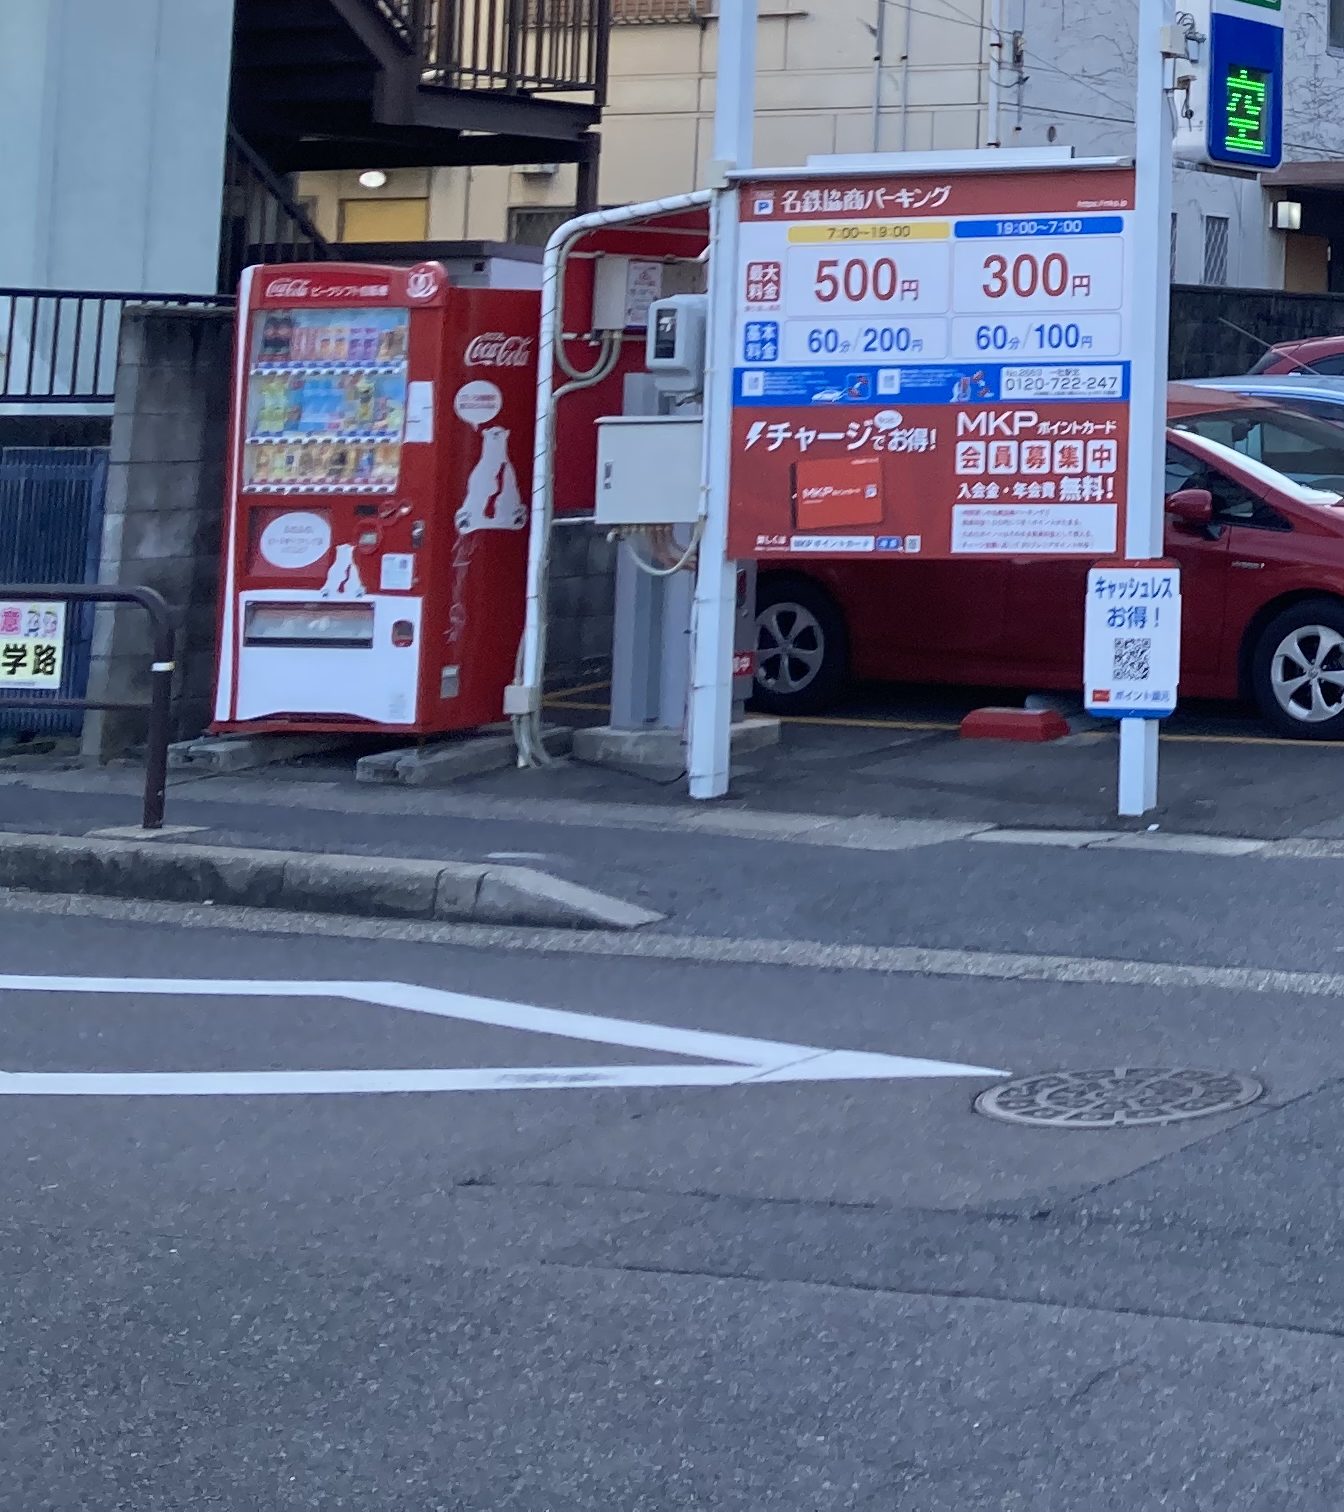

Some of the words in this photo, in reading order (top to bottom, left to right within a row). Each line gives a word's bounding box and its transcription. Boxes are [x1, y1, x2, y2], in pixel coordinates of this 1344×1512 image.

[1225, 69, 1265, 151] 空
[781, 185, 952, 213] 名鉄協商パーキング
[814, 258, 919, 302] 500円
[982, 253, 1091, 298] 300円
[464, 334, 534, 366] Coca-Cola
[1006, 377, 1118, 391] 0120-722-247
[961, 444, 1112, 469] 会員募集中
[1094, 576, 1173, 599] キャッシュレス
[2, 644, 56, 675] 学路
